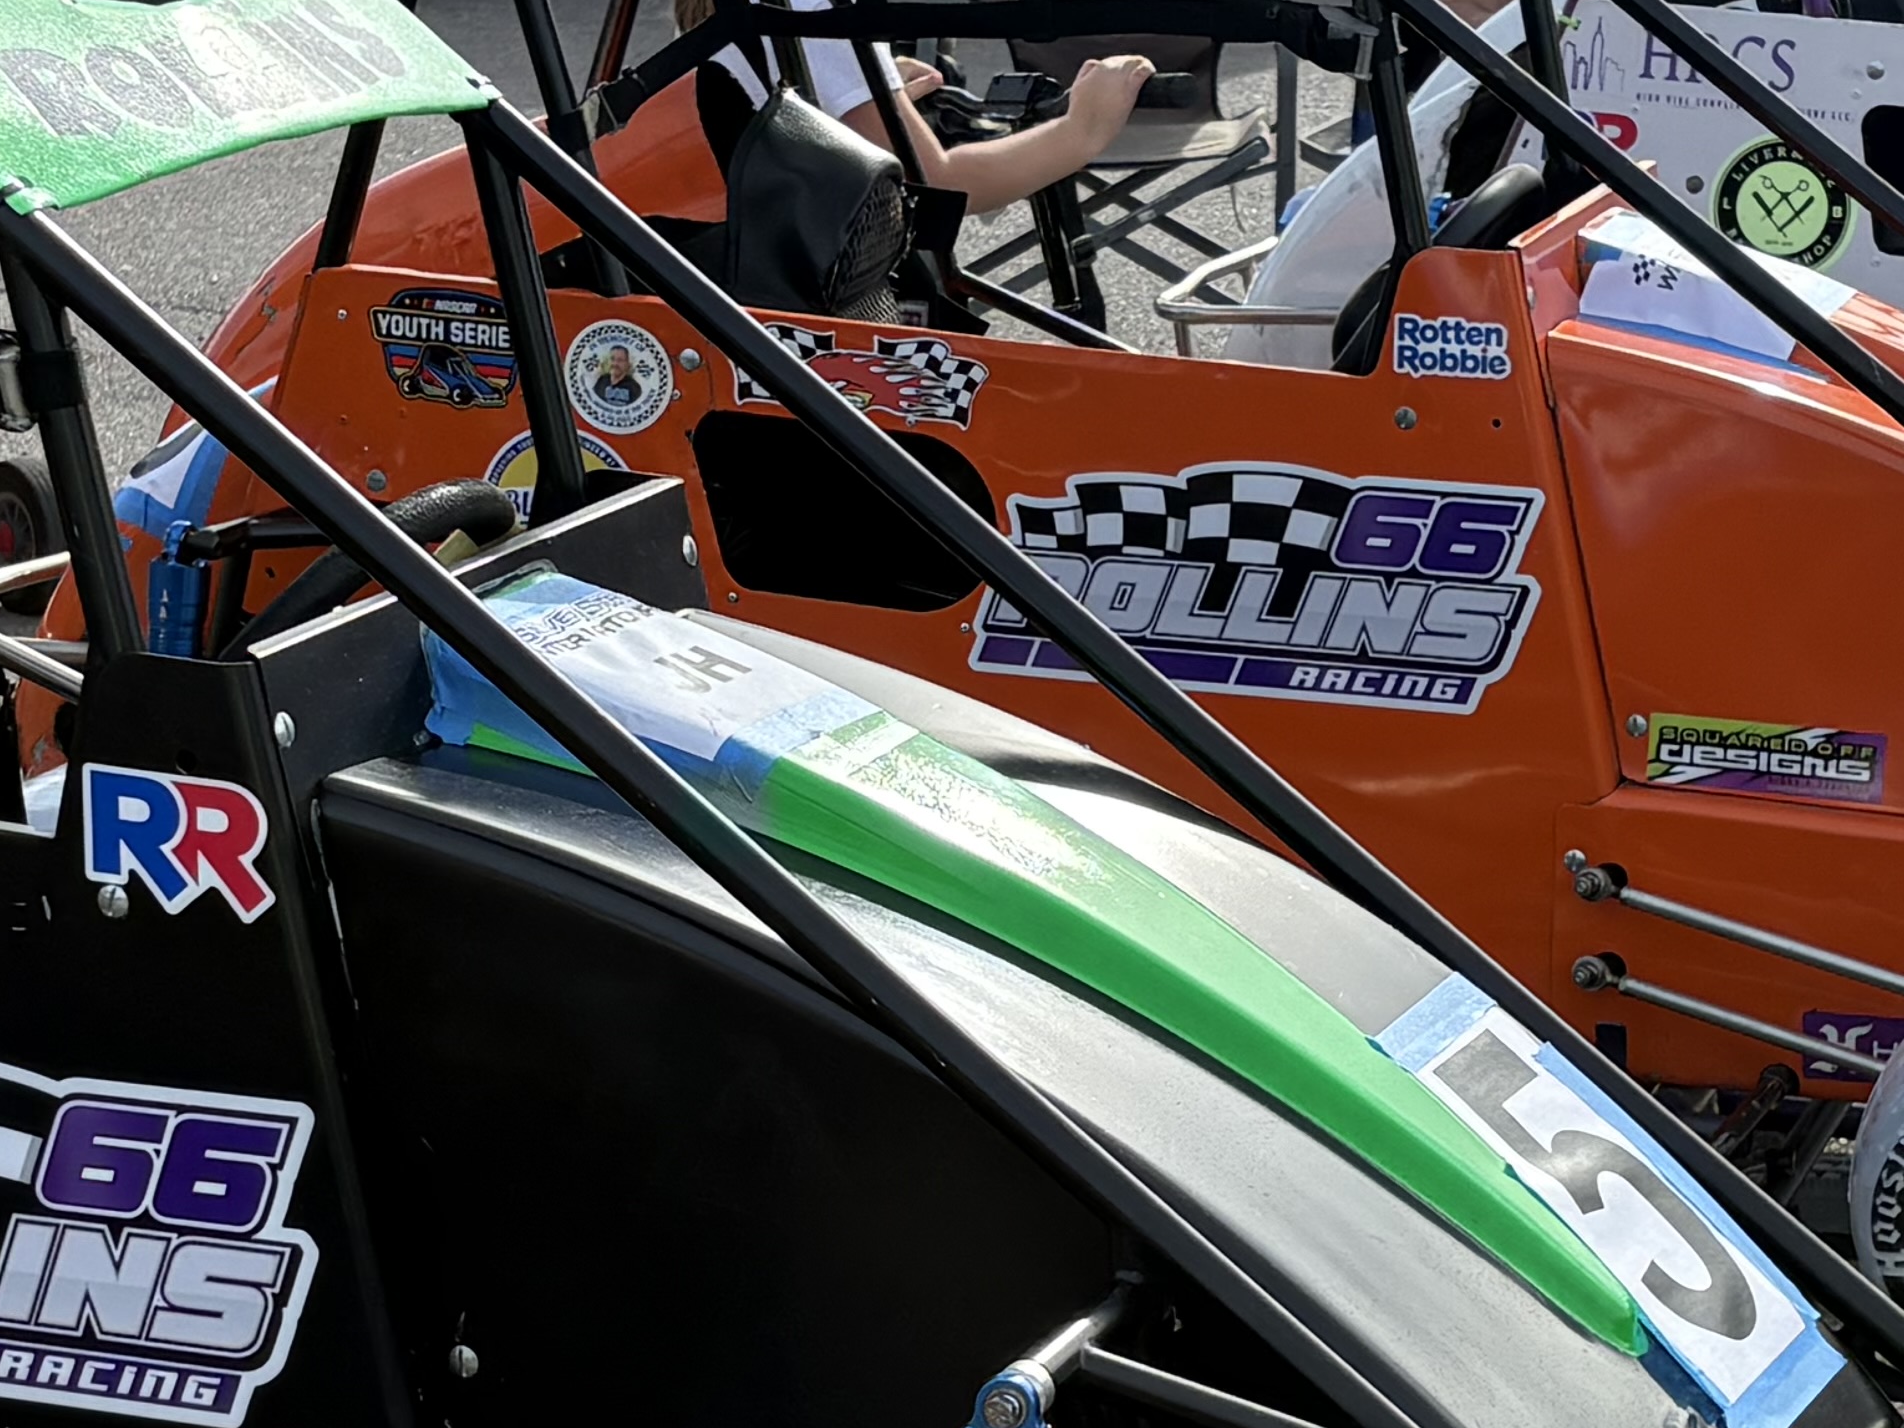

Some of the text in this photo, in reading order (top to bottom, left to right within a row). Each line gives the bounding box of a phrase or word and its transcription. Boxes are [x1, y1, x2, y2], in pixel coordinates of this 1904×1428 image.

[433, 299, 478, 314] NASCAR
[376, 313, 512, 348] YOUTH SERIE
[1397, 316, 1504, 346] Rotten
[1395, 343, 1509, 376] Robbie
[1333, 491, 1526, 579] 66
[652, 644, 753, 695] JH
[1289, 666, 1461, 701] RACING
[1661, 726, 1875, 760] SQUARED OFF
[36, 1101, 286, 1229] 66
[1432, 1027, 1758, 1341] 5
